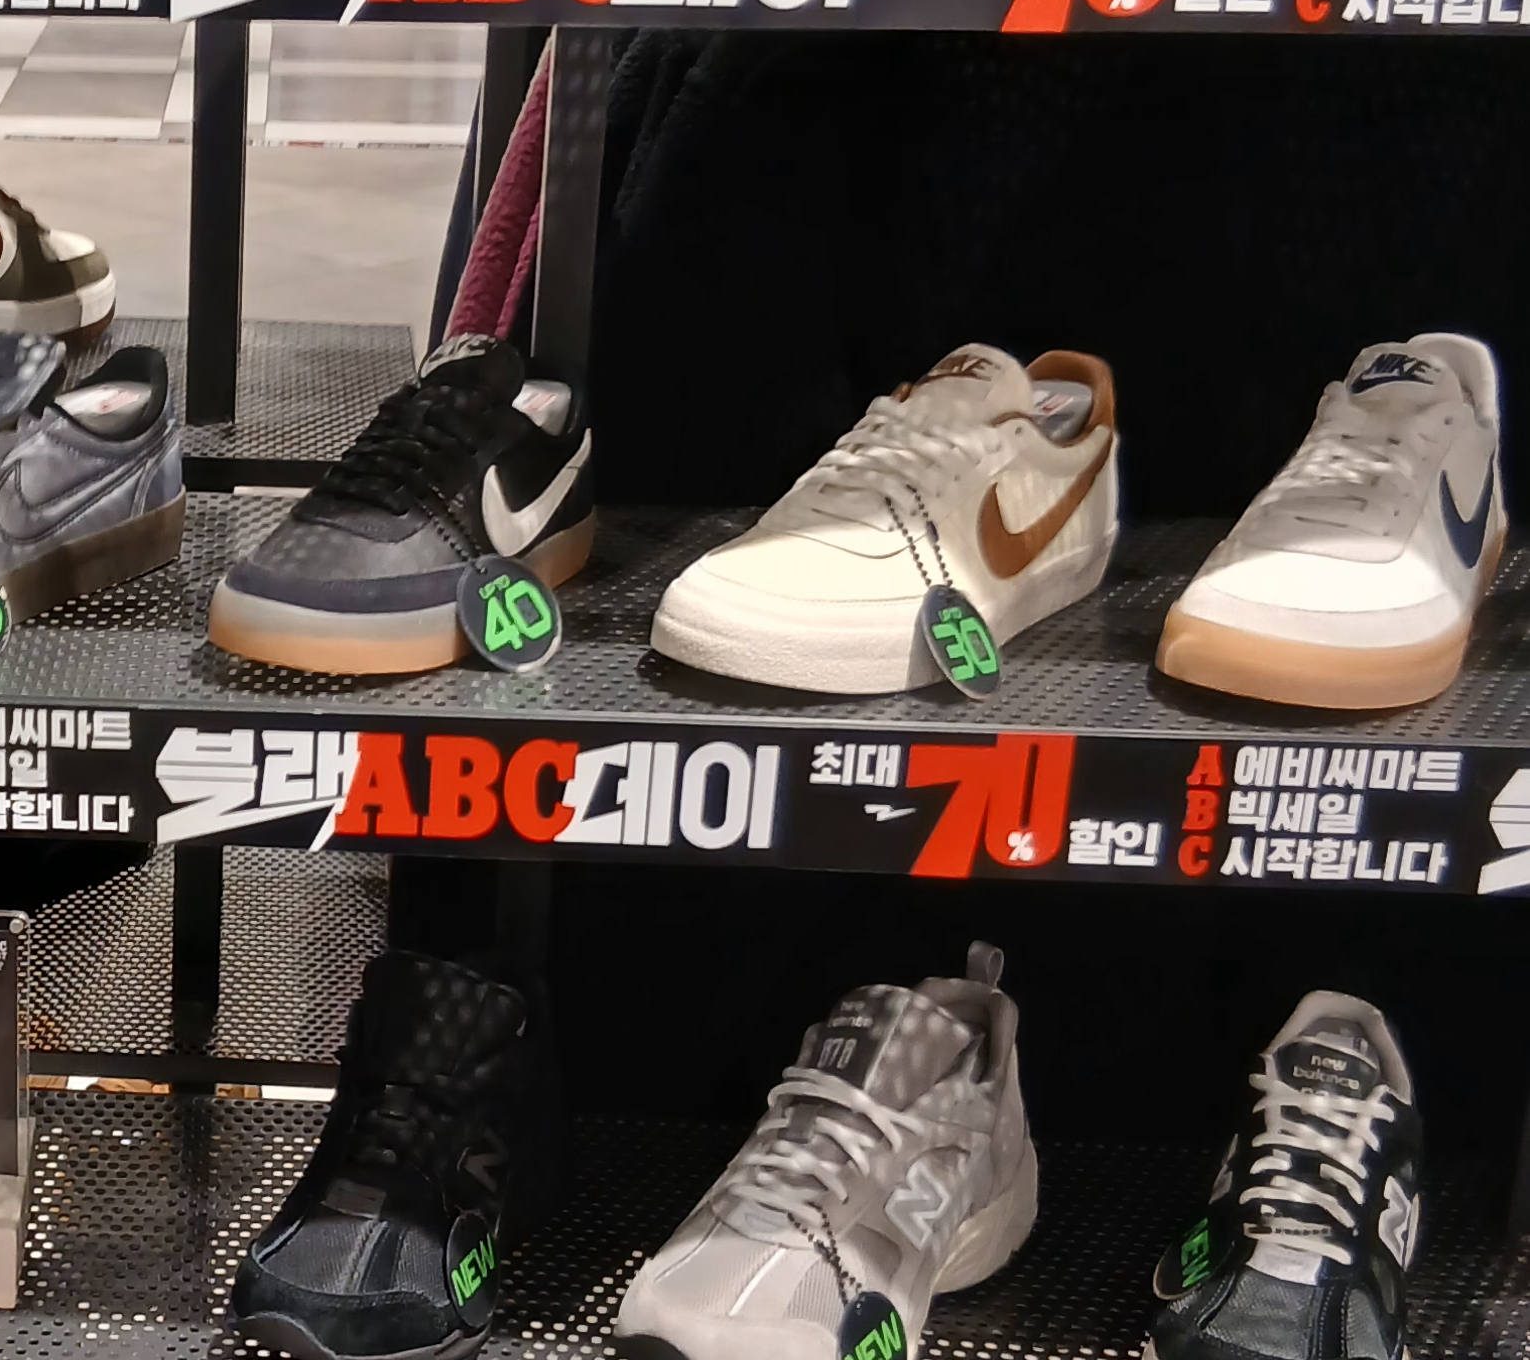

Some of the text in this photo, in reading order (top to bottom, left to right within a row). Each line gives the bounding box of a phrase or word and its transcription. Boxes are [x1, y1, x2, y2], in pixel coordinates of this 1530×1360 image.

[1185, 744, 1463, 793] A 에비씨마트
[809, 741, 902, 789] 최대
[1067, 818, 1163, 867] 할인
[1181, 790, 1362, 834] B 빅세일
[1177, 834, 1448, 885] C 시작합니다
[1310, 1054, 1348, 1072] new
[451, 1232, 496, 1307] NEW
